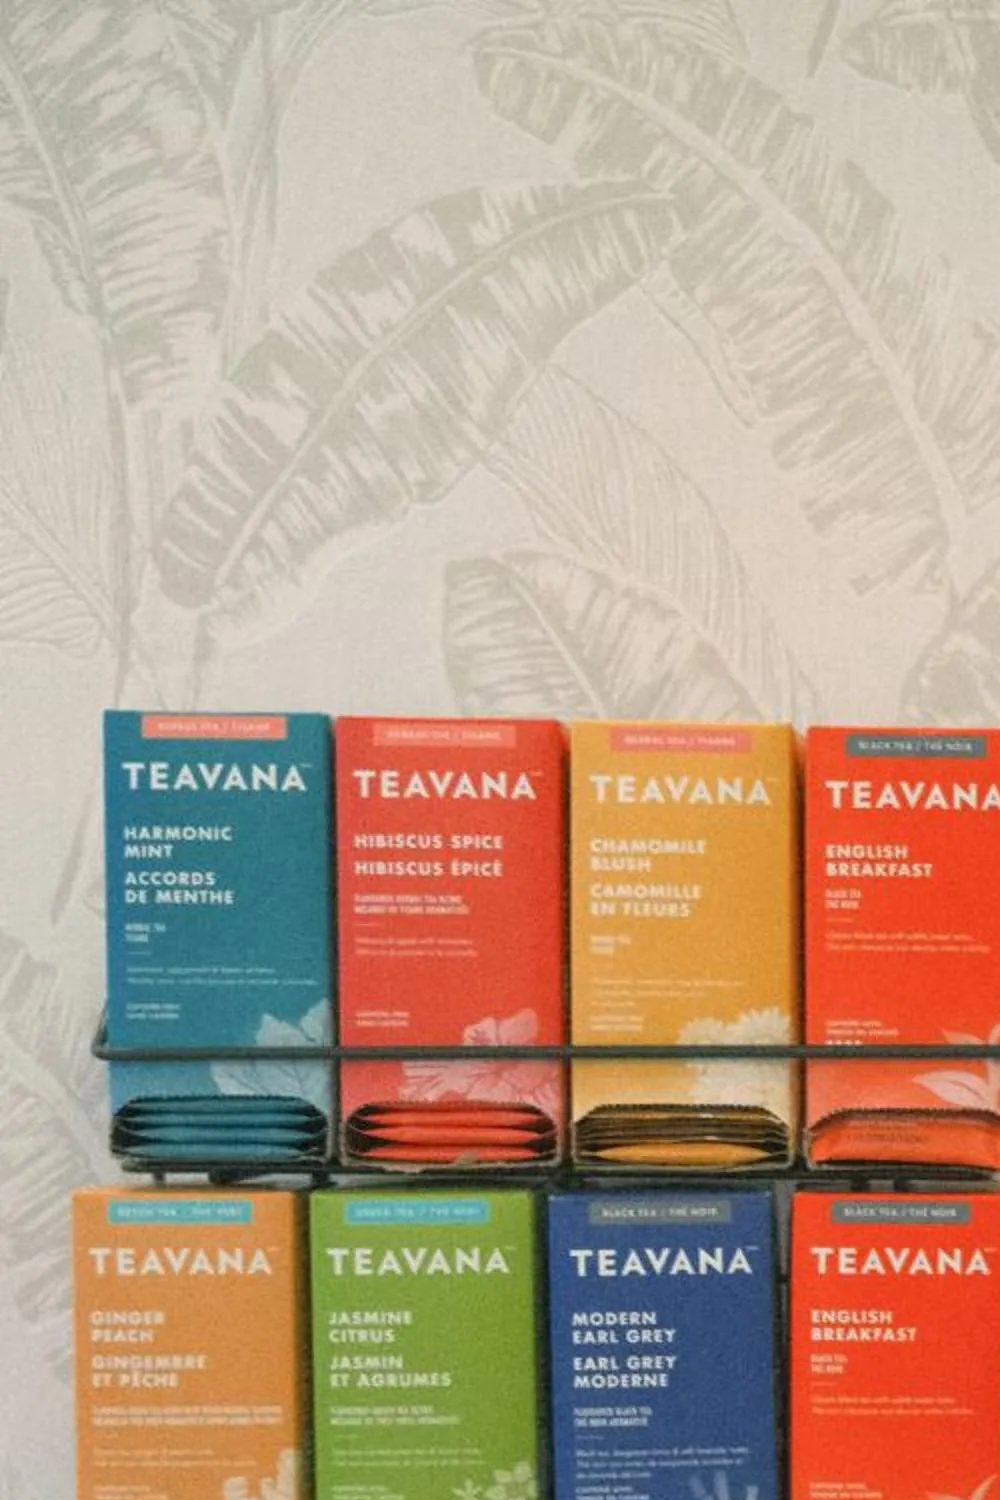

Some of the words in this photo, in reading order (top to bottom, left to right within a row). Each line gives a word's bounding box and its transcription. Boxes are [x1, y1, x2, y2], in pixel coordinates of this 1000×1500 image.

[121, 762, 307, 791] TEAVANA
[353, 769, 537, 800] TEAVANA
[589, 774, 772, 805] TEAVANA
[123, 826, 233, 841] HARMONIC
[354, 833, 443, 849] HIBISCUS
[451, 834, 503, 849] SPICE
[123, 844, 174, 858] MINT
[591, 839, 705, 854] CHAMOMILE
[825, 844, 907, 859] ENGLISH
[354, 861, 444, 876] HIBISCUS
[590, 856, 650, 872] BLUSH
[826, 863, 932, 878] BREAKFAST
[124, 872, 215, 886] ACCORDS
[125, 890, 147, 904] DE
[155, 890, 235, 904] MENTHE
[591, 883, 701, 900] CAMOMILLE
[590, 902, 615, 916] EN
[623, 902, 689, 917] FLEURS
[89, 1247, 272, 1276] TEAVANA
[327, 1247, 510, 1276] TEAVANA
[569, 1247, 752, 1276] TEAVANA
[810, 1247, 991, 1276] TEAVANA
[91, 1311, 163, 1325] GINGER
[329, 1311, 411, 1325] JASMINE
[573, 1312, 656, 1326] MODERN
[811, 1309, 892, 1324] ENGLISH
[92, 1328, 154, 1343] PEACH
[329, 1329, 395, 1343] CITRUS
[573, 1330, 618, 1344] EARL
[626, 1329, 676, 1343] GREY
[811, 1327, 917, 1342] BREAKFAST
[93, 1355, 206, 1370] GINGEMBRE
[330, 1355, 402, 1370] JASMIN
[573, 1356, 619, 1371] EARL
[627, 1355, 677, 1370] GREY
[93, 1374, 111, 1388] ET
[330, 1373, 351, 1388] ET
[357, 1372, 452, 1388] AGRUMES
[573, 1374, 668, 1389] MODERNE
